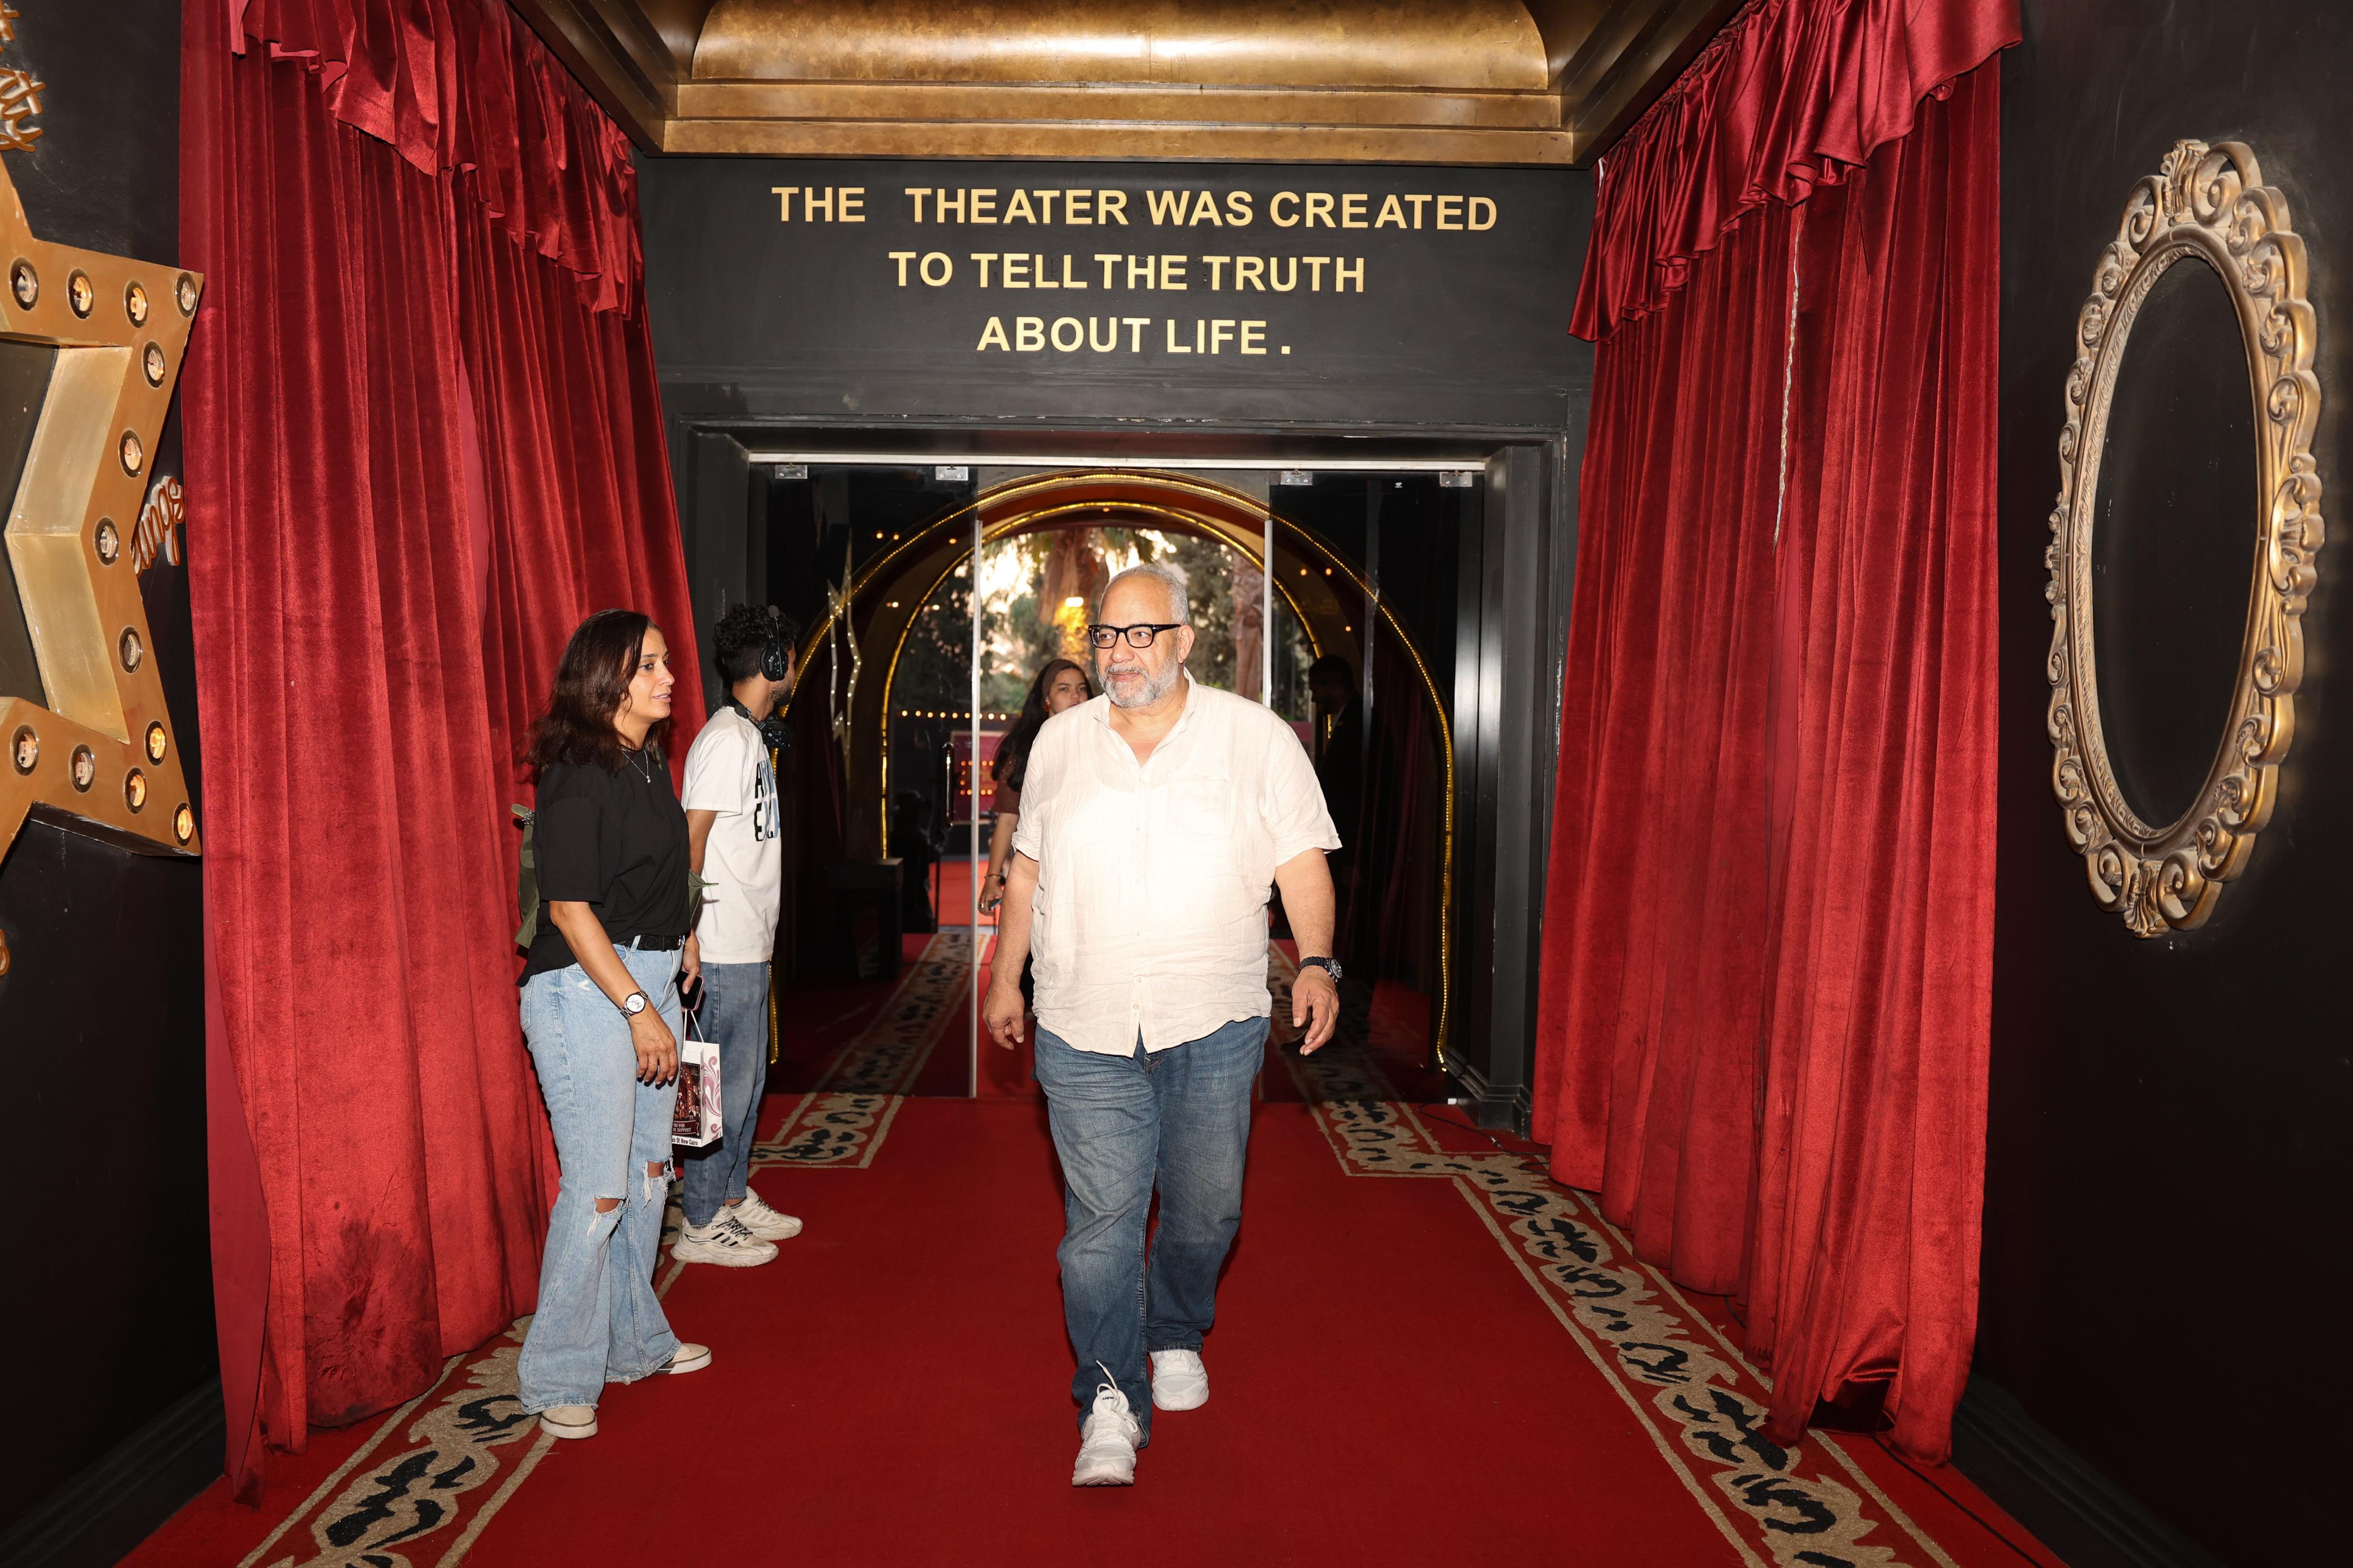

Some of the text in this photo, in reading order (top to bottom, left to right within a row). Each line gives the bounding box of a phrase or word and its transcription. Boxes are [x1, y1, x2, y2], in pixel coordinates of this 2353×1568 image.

[771, 186, 1497, 231] THE THEATER WAS CREATED
[887, 251, 1365, 293] TO TELL THE TRUTH
[976, 316, 1151, 353] ABOUT
